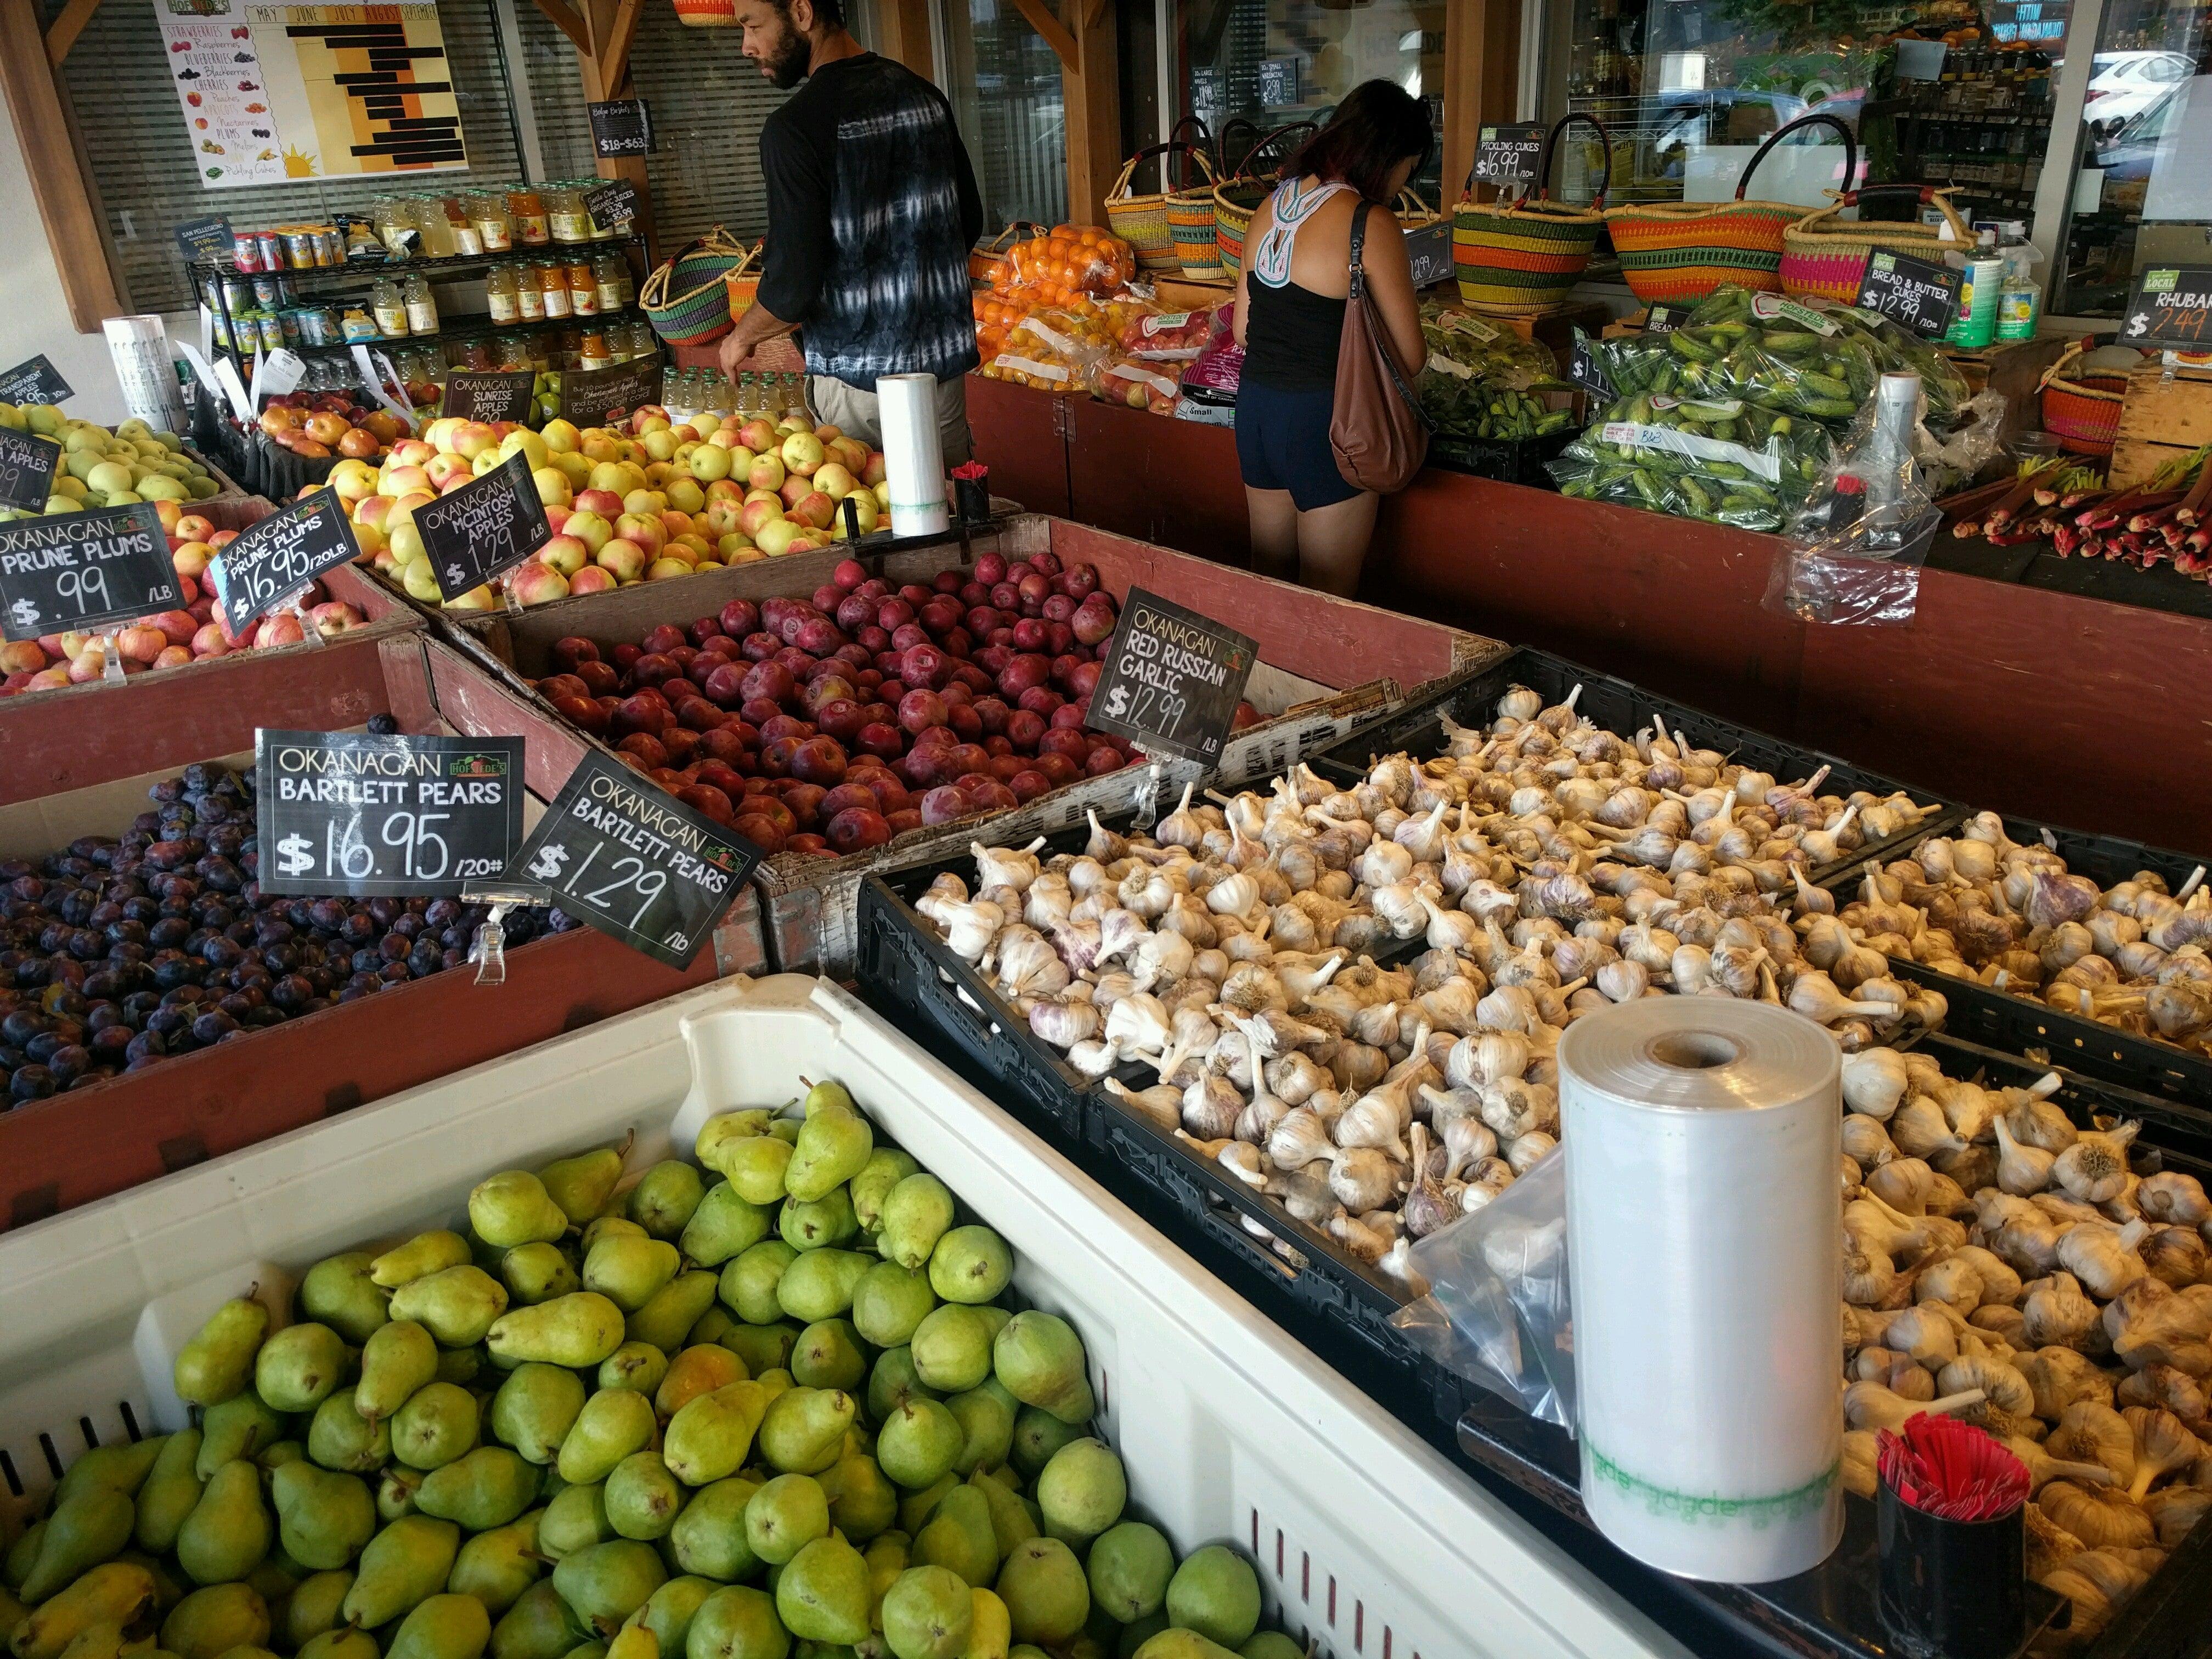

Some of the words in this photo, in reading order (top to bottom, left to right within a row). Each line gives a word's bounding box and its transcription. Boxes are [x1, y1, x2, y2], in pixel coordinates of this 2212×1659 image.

[257, 8, 278, 22] MAY
[297, 7, 318, 21] JUNE
[335, 7, 356, 21] JULY
[365, 7, 399, 20] AUGUST
[401, 5, 437, 20] SEPTEMBER
[167, 26, 222, 37] STRAWBERRIES
[193, 38, 240, 52] Raspberries
[184, 53, 233, 65] BLUEBERRIES
[204, 66, 250, 77] Blackberries
[194, 80, 228, 91] CHERRIES
[210, 92, 240, 102] Peaches
[217, 116, 259, 127] Nectarines
[216, 128, 240, 139] PLUMS
[1481, 142, 1513, 150] PICKLING
[1515, 143, 1539, 152] CUKES
[225, 164, 253, 179] Pickling
[255, 163, 276, 173] Cukes
[1476, 151, 1519, 177] $16.99
[590, 198, 614, 214] ORGANIC
[614, 190, 634, 203] JUICES
[194, 223, 224, 235] PELLEGRINO
[1872, 269, 1903, 285] BREAD
[1904, 279, 1912, 289] &
[1914, 281, 1949, 301] BUTTER
[1892, 286, 1921, 303] CUKES
[2146, 279, 2175, 288] LOCAL
[1649, 321, 1672, 332] BREAD
[0, 370, 42, 396] TRANSPARENT
[14, 382, 39, 398] APPLES
[455, 380, 511, 391] OKANAGAN
[473, 390, 514, 402] SUNRISE
[473, 402, 509, 413] APPLES
[1189, 407, 1212, 415] Small
[8, 450, 49, 473] APPLES
[426, 476, 506, 530] OKANAGAN
[452, 488, 516, 535] MCINTOSH
[0, 518, 116, 554] OKANAGAN
[468, 507, 514, 545] APPLES
[1, 544, 79, 575] PRUNE
[83, 533, 153, 561] PLUMS
[219, 511, 299, 574] OKANAGAN
[230, 543, 272, 581] PRUNE
[273, 516, 323, 549] PLUMS
[446, 526, 515, 586] $1.29
[234, 539, 309, 621] $16.95
[149, 585, 173, 603] /LB
[1134, 609, 1217, 658] OKANAGAN
[1125, 629, 1159, 658] RED
[1160, 644, 1227, 687] RUSSIAN
[1119, 654, 1183, 695] GARLIC
[278, 747, 441, 777] OKANAGAN
[280, 777, 409, 805] BARTLETT
[419, 782, 501, 805] PEARS
[590, 776, 708, 853] OKANAGAN
[276, 811, 450, 880] $16.95
[454, 858, 503, 878] /20#
[572, 797, 671, 861] BARTLETT
[667, 850, 729, 894] PEARS
[528, 841, 667, 929] $1.29
